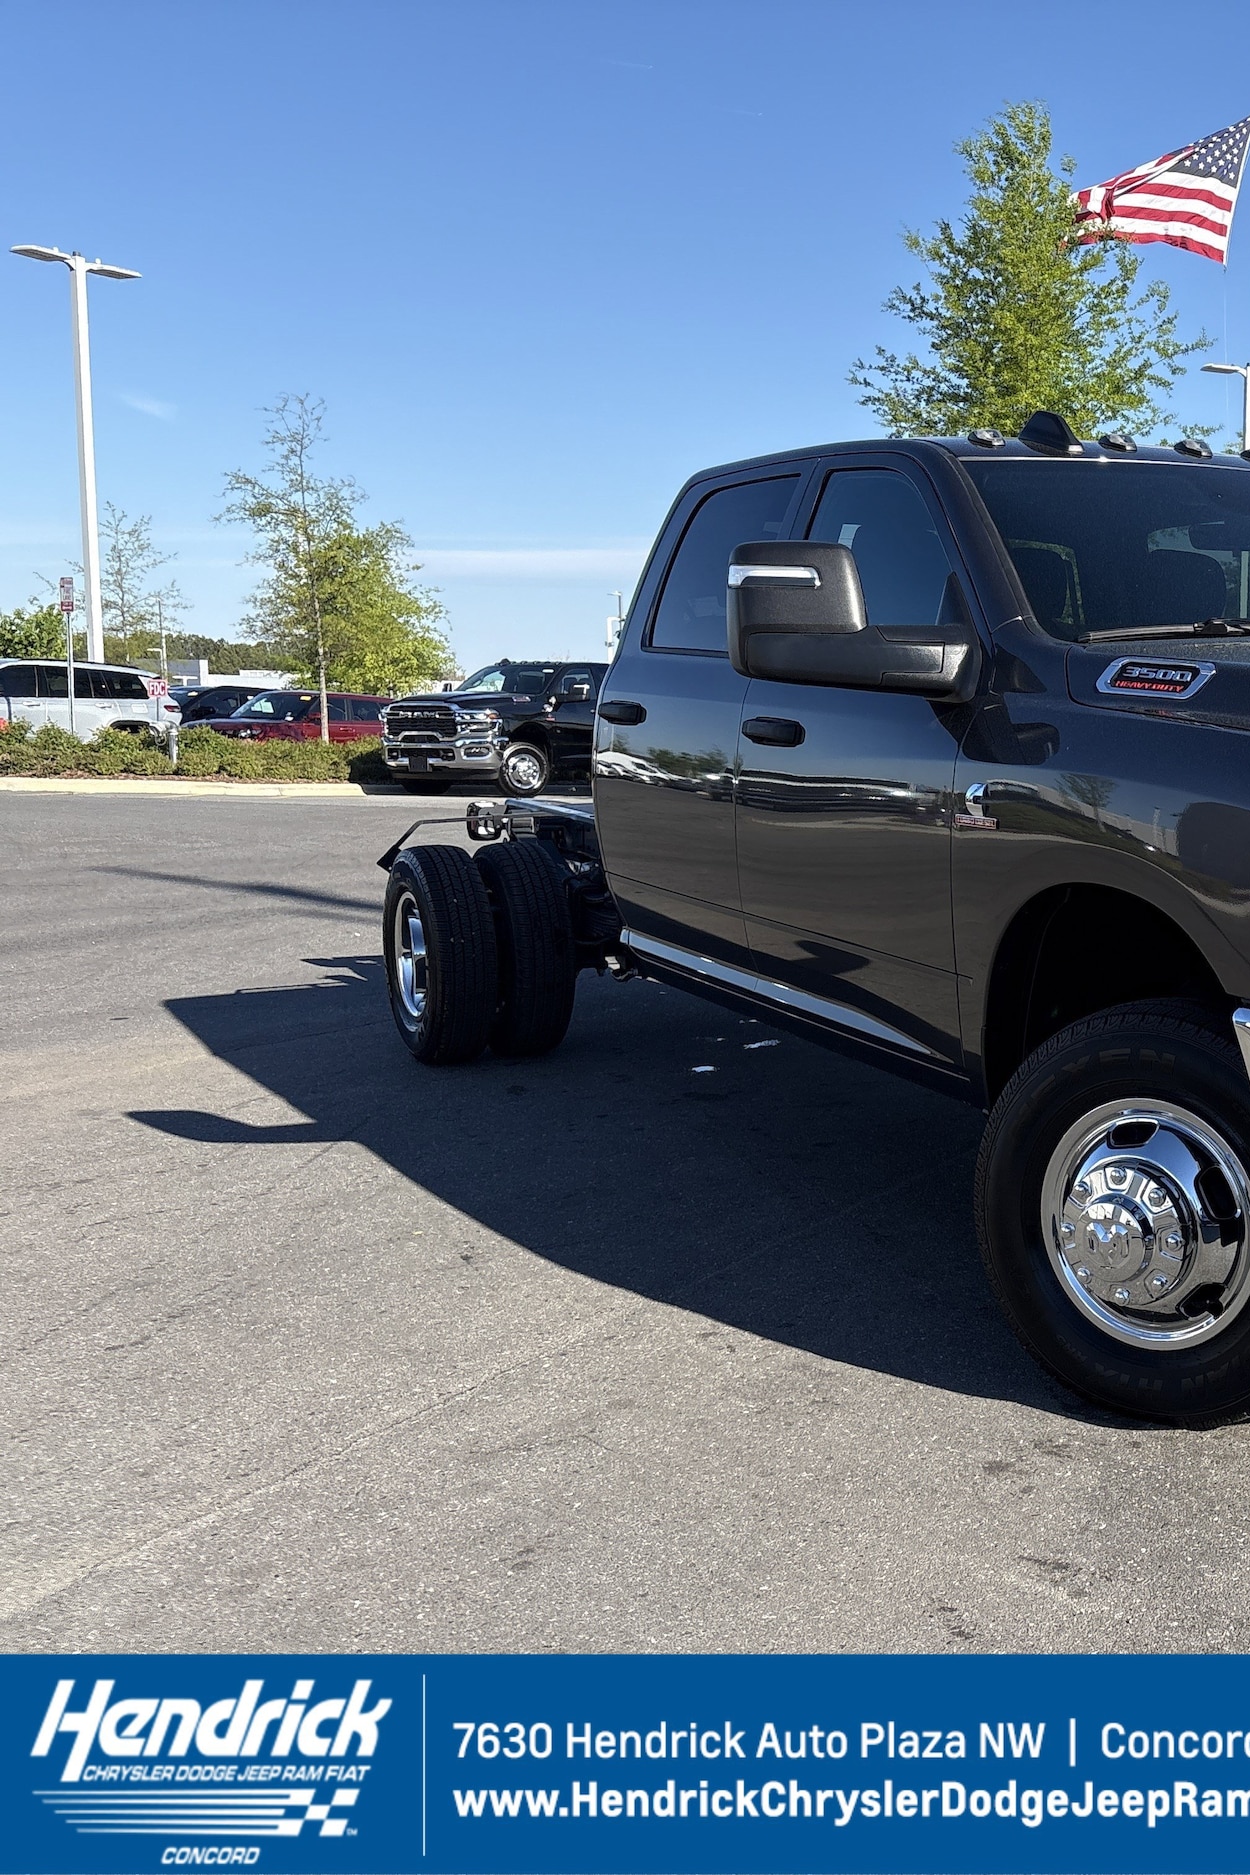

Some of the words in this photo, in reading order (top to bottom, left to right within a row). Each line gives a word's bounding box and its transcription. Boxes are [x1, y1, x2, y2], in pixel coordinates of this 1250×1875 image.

[1122, 666, 1192, 681] 3500
[149, 682, 165, 696] FDC
[1115, 680, 1152, 691] HEAVY
[1151, 683, 1185, 693] DUTY
